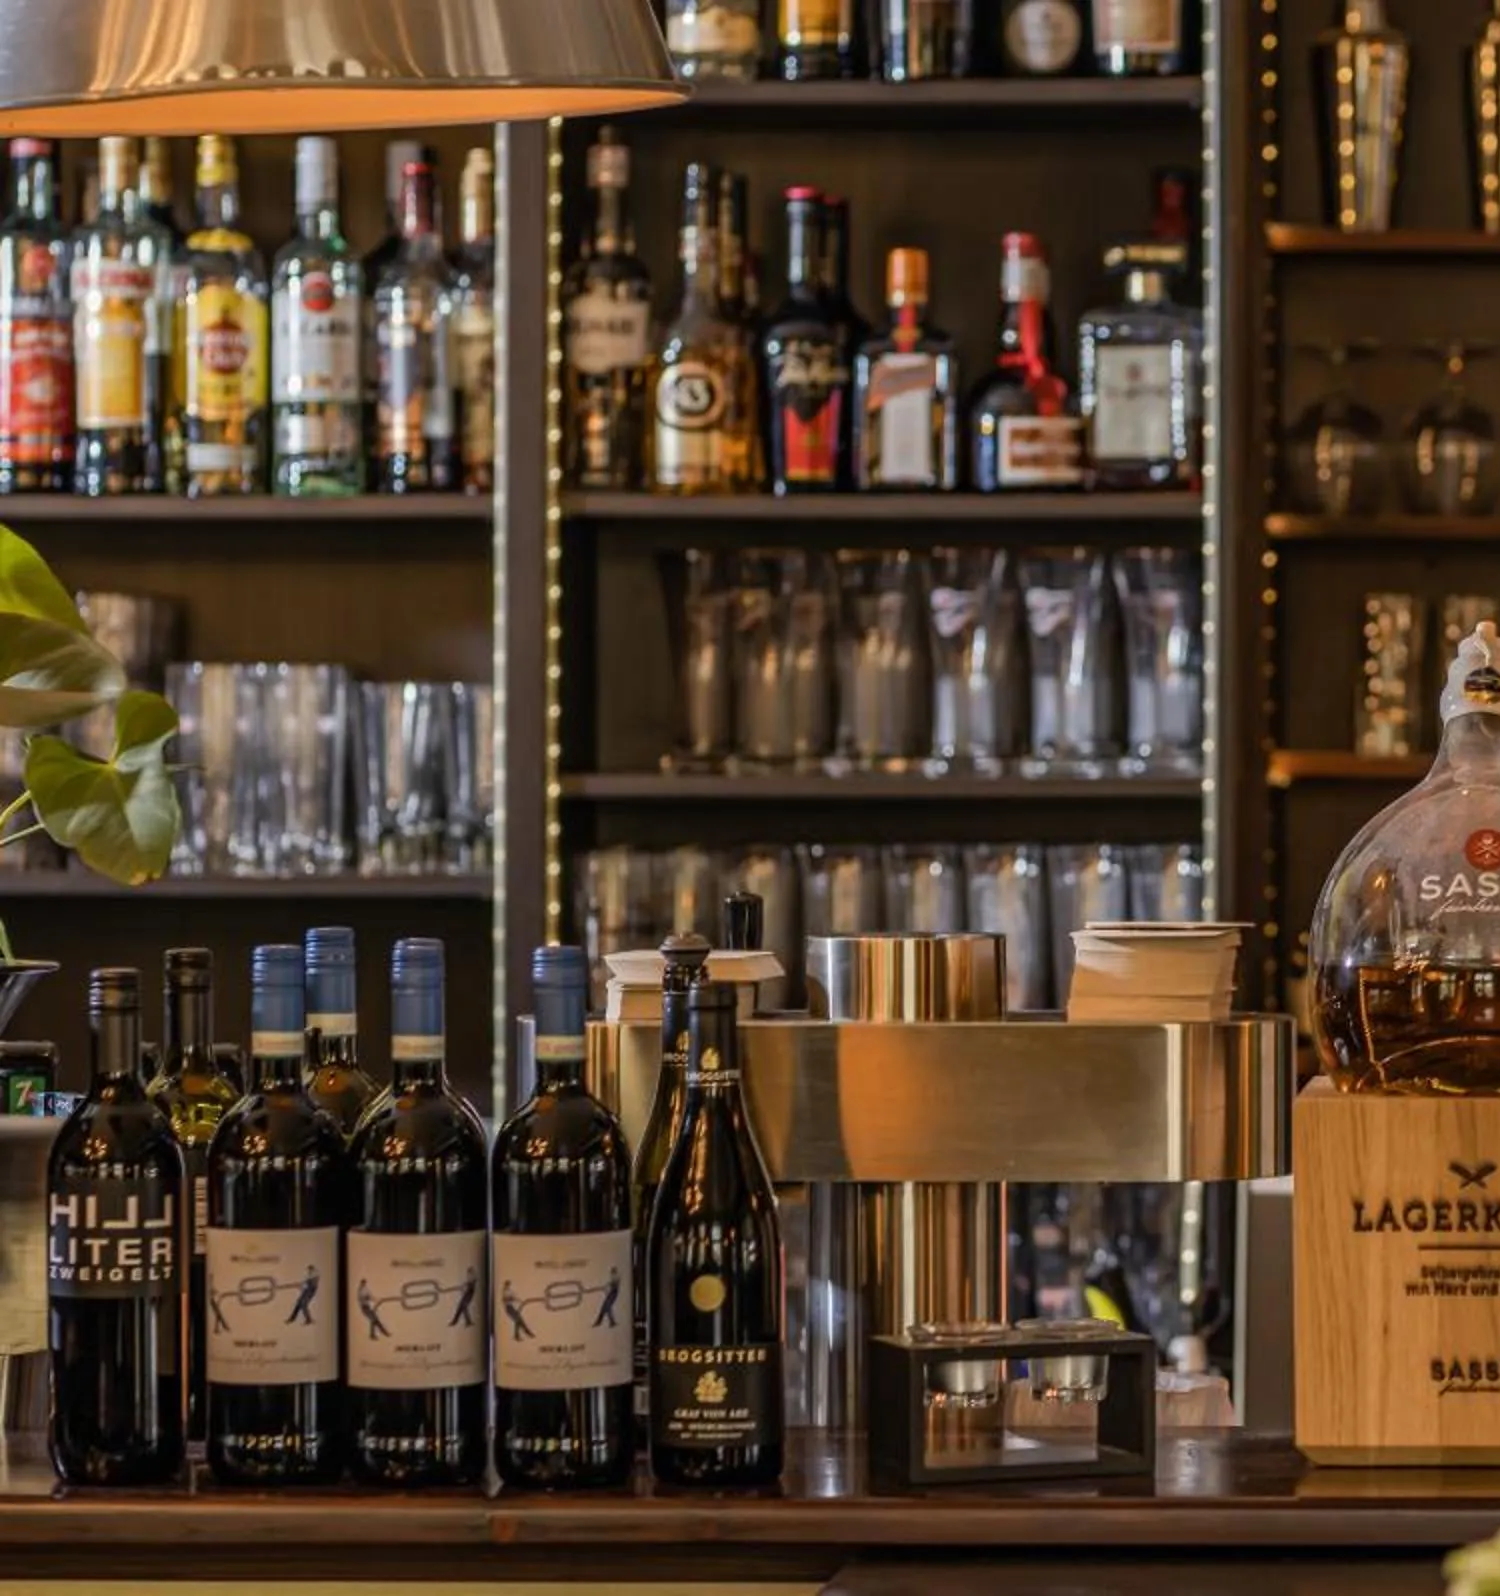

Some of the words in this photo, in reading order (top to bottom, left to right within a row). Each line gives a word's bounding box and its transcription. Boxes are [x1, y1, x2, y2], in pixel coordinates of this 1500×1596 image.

[49, 1237, 174, 1266] LITER
[49, 1264, 174, 1282] ZWEIGELT
[1471, 1281, 1499, 1297] und
